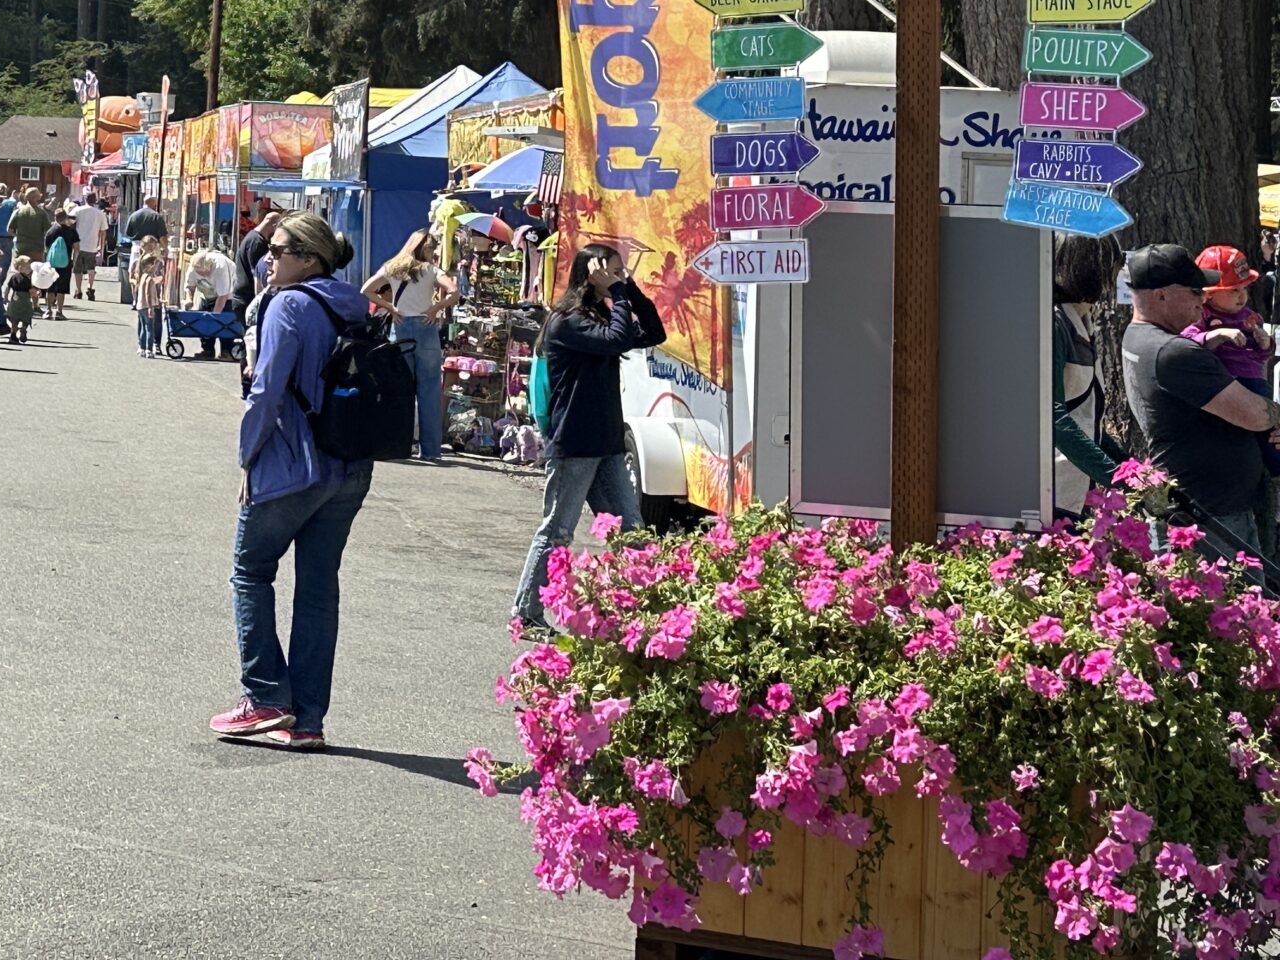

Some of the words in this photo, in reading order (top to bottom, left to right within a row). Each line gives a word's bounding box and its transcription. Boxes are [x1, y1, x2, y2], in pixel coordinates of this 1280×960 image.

[740, 35, 774, 57] CATS
[1031, 36, 1125, 67] POULTRY
[724, 82, 792, 99] COMMUNITY
[742, 99, 776, 116] STAGE
[1040, 90, 1107, 123] SHEEP
[736, 139, 787, 168] DOGS
[1043, 143, 1092, 162] RABBITS
[1029, 162, 1062, 179] CAVY
[1074, 164, 1102, 182] PETS
[724, 192, 795, 222] FLORAL
[1011, 182, 1102, 213] PRESENTATION
[1034, 205, 1072, 227] STAGE
[720, 250, 767, 275] FIRST
[774, 249, 801, 274] AID
